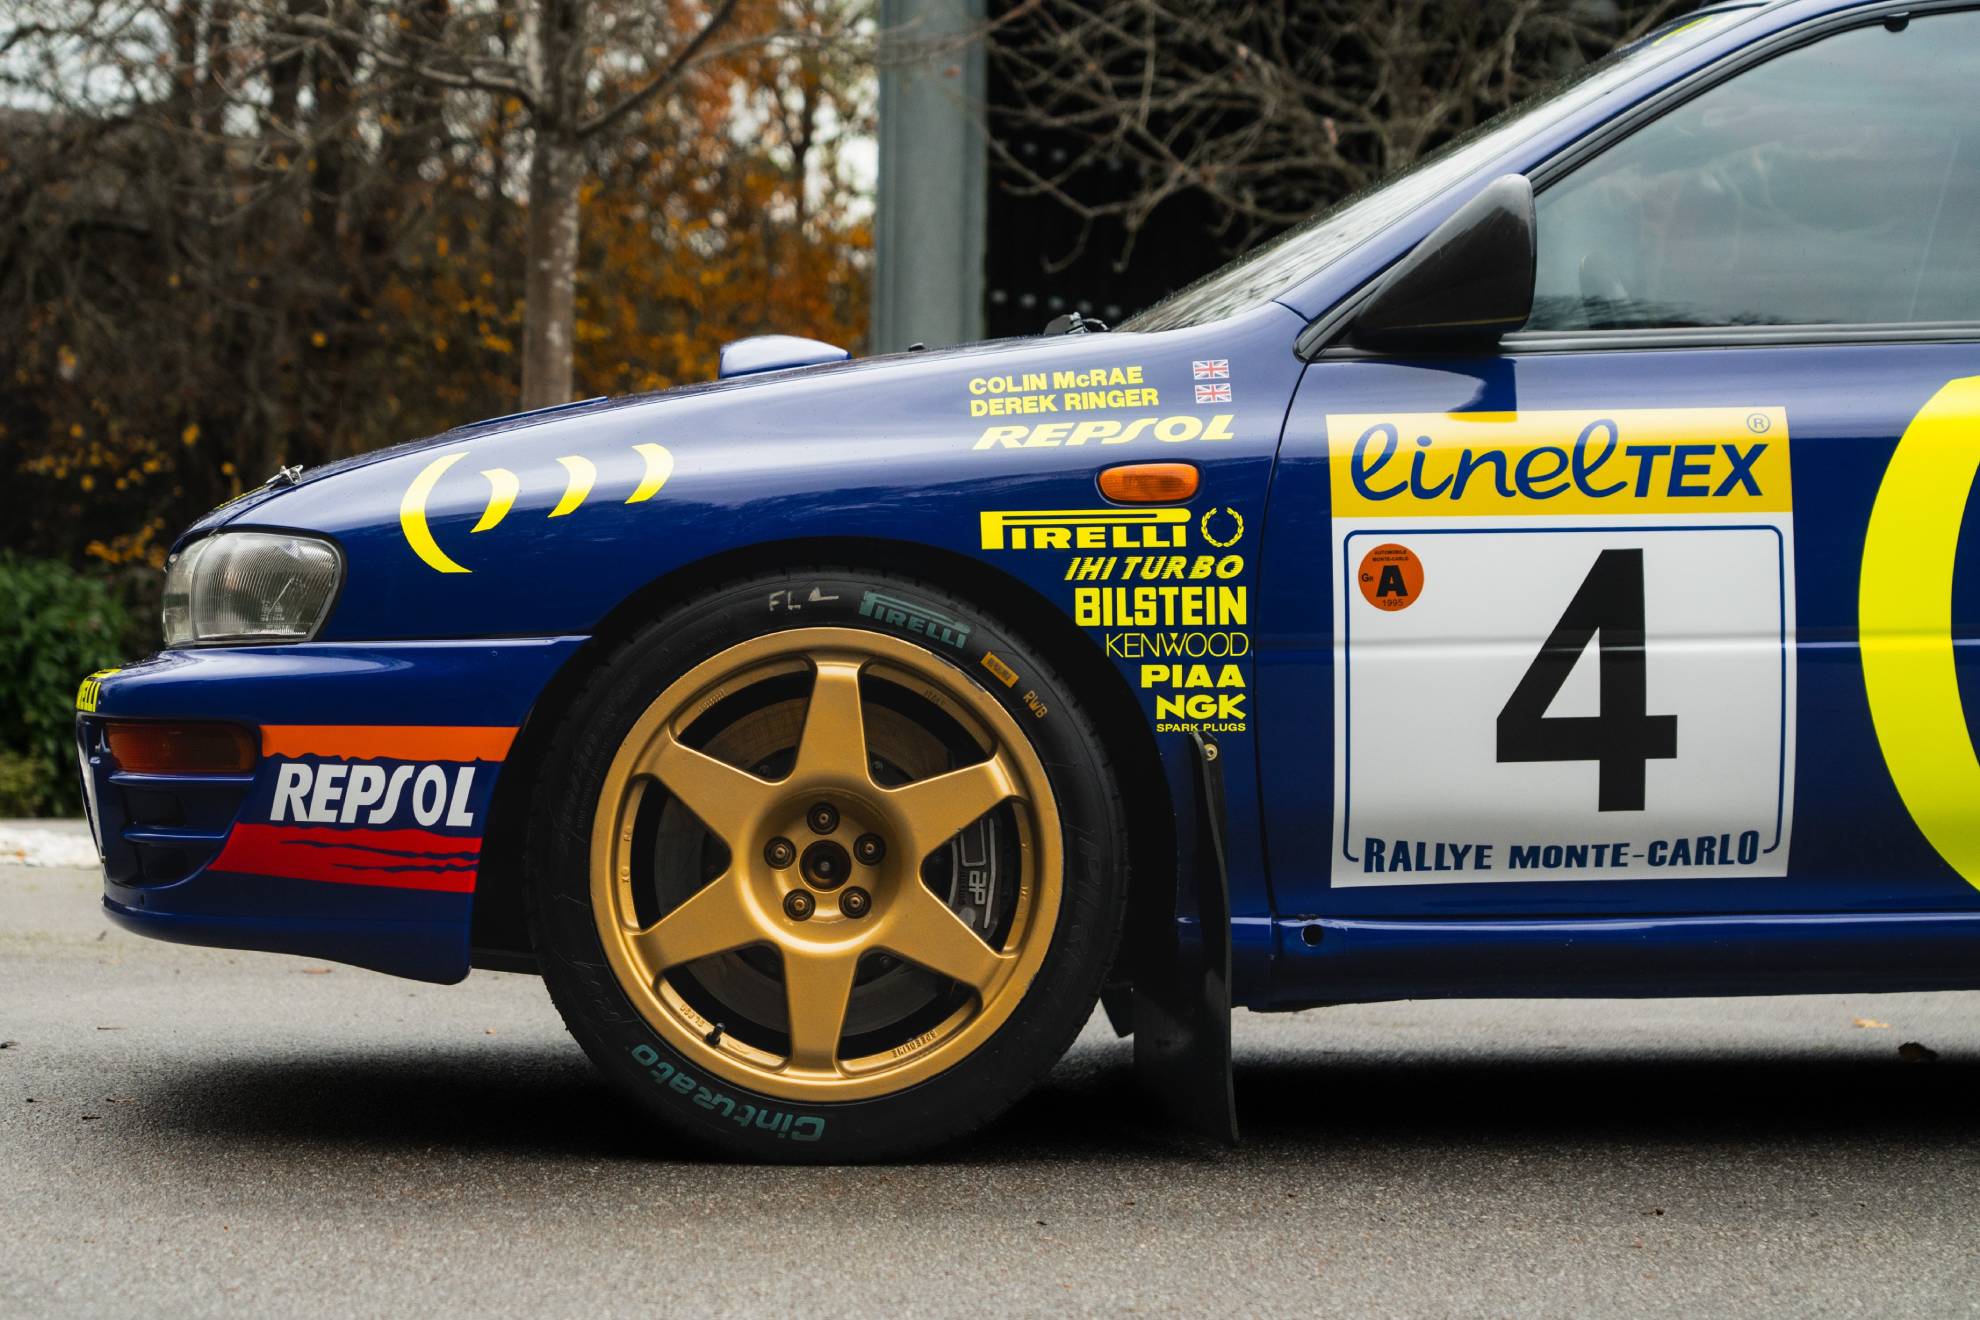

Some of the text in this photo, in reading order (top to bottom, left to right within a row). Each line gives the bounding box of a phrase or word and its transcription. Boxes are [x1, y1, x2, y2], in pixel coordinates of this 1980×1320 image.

[969, 366, 1144, 395] COLIN McRAE
[970, 388, 1159, 417] DEREK RINGER
[972, 415, 1234, 450] REPSOL
[980, 508, 1192, 550] PIRELLI
[1064, 555, 1244, 581] IHI TURBO
[1376, 565, 1408, 597] A
[858, 590, 971, 649] PIRELLI
[1075, 586, 1247, 626] BILSTEIN
[1105, 632, 1249, 658] KENWOOD
[1141, 664, 1246, 688] PIAA
[1496, 548, 1677, 813] 4
[1156, 694, 1246, 720] NGK
[1156, 722, 1246, 732] SPARK PLUGS
[269, 763, 475, 827] REPSOL
[1363, 830, 1760, 873] RALLYE MONTE-CARLO
[631, 1044, 826, 1142] Cinturato
